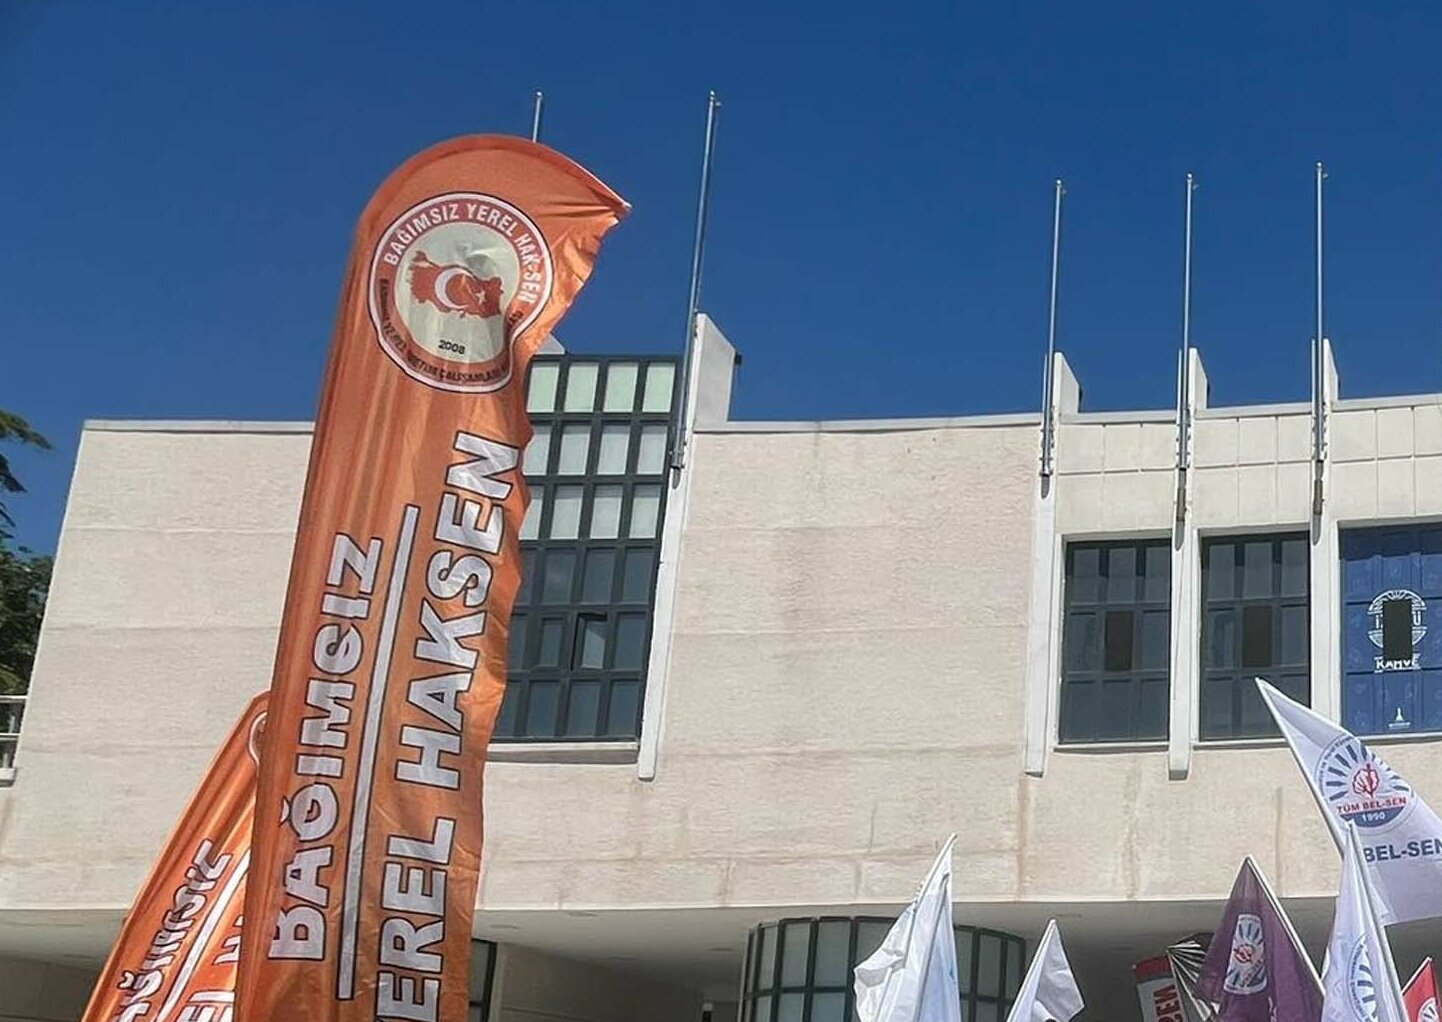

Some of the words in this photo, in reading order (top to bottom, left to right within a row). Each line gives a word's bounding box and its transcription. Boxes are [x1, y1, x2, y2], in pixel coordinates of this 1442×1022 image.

[385, 203, 460, 266] BAĞIMSIZ
[467, 203, 518, 237] YEREL
[438, 339, 466, 354] 2008
[395, 431, 520, 790] HAKSEN
[1363, 796, 1407, 809] BEL-SEN
